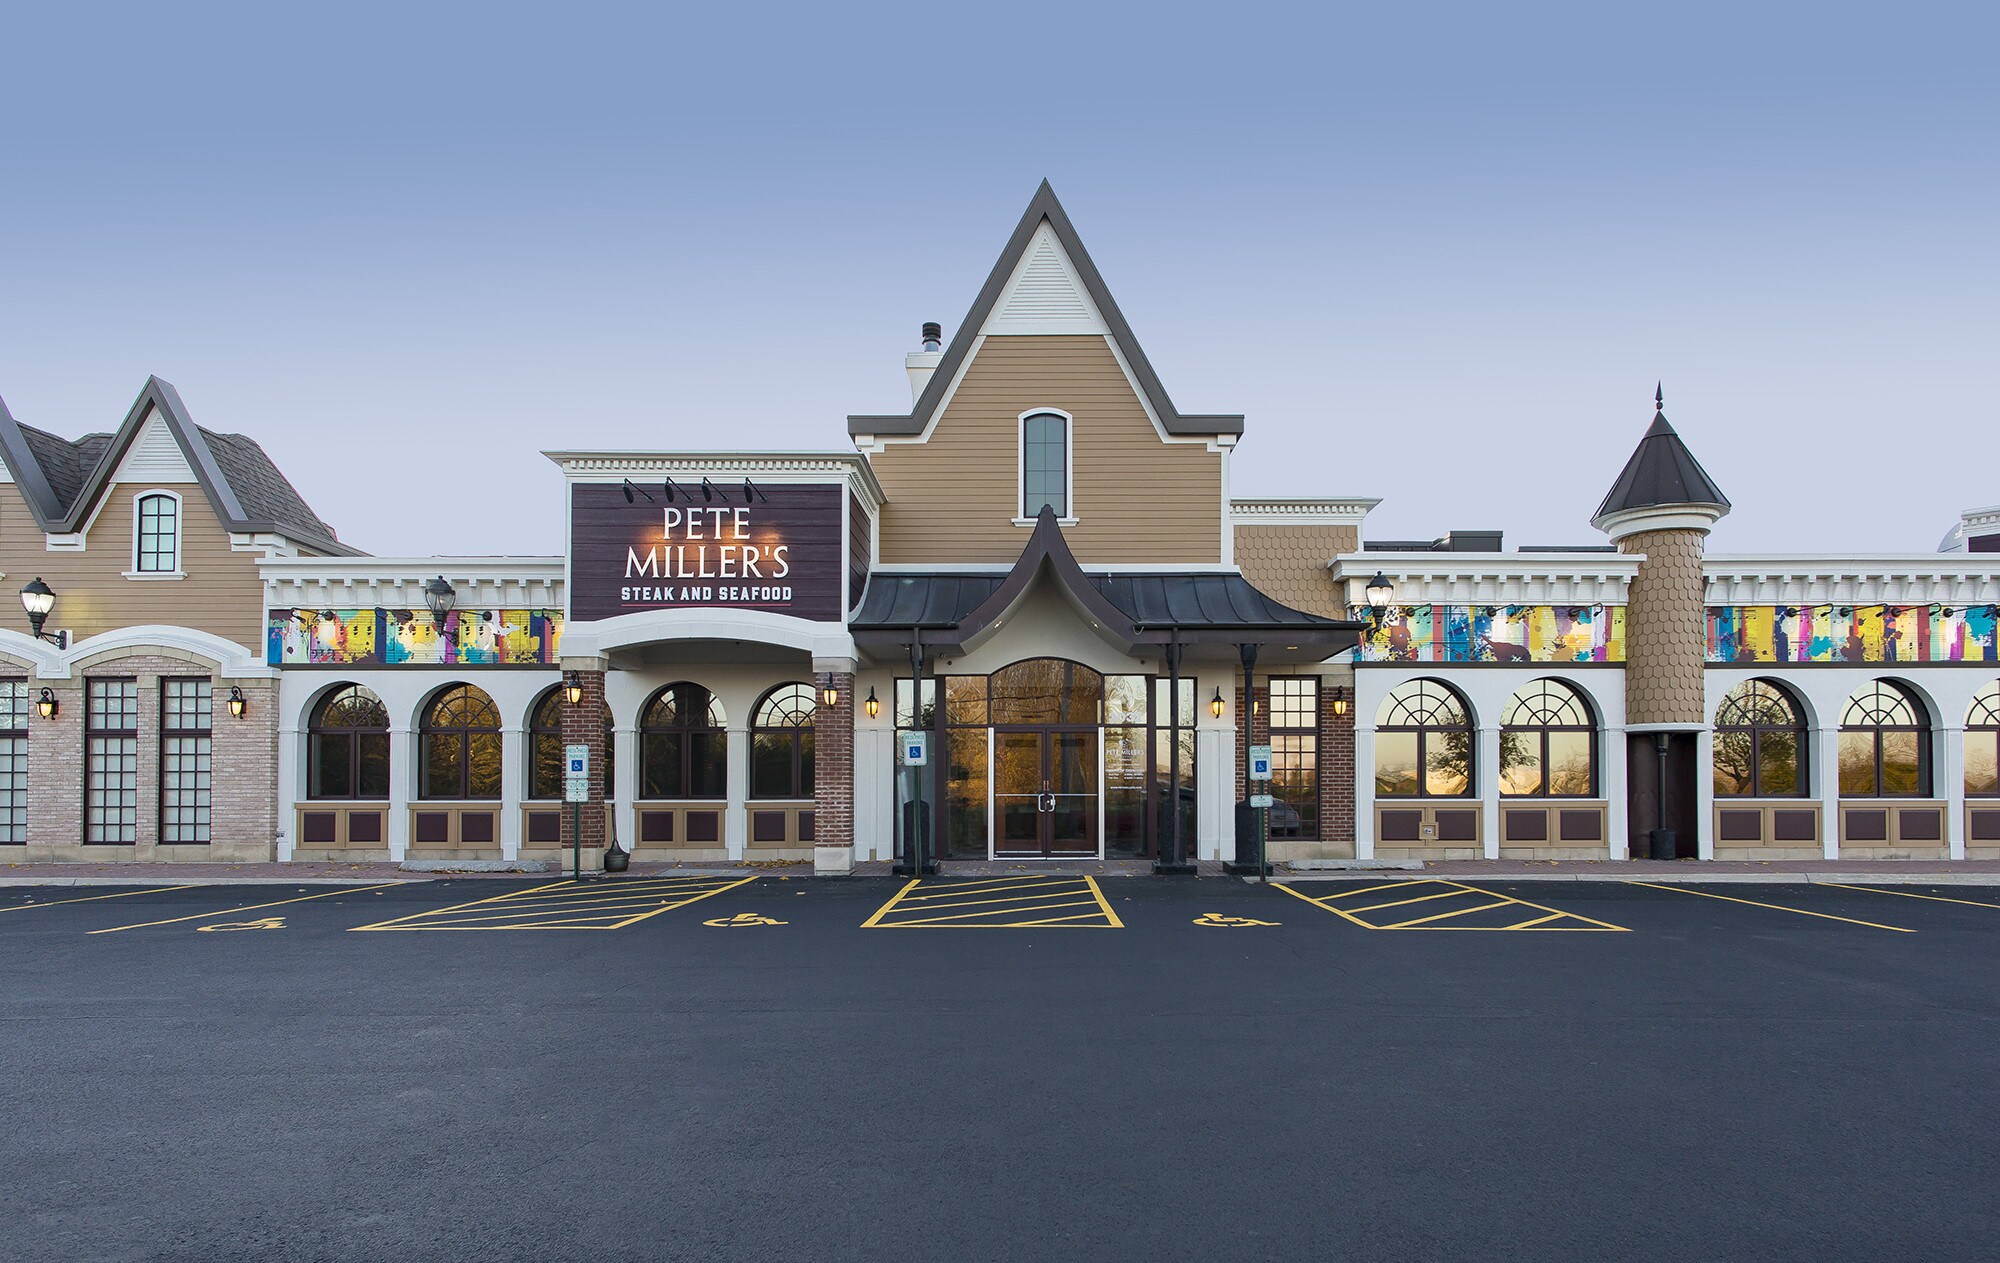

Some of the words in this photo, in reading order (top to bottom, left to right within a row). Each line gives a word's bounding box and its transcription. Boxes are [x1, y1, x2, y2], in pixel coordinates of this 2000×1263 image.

[663, 507, 751, 540] PETE
[624, 545, 790, 579] MILLER'S
[621, 586, 675, 601] STEAK
[680, 586, 713, 601] AND
[718, 586, 793, 601] SEAFOOD
